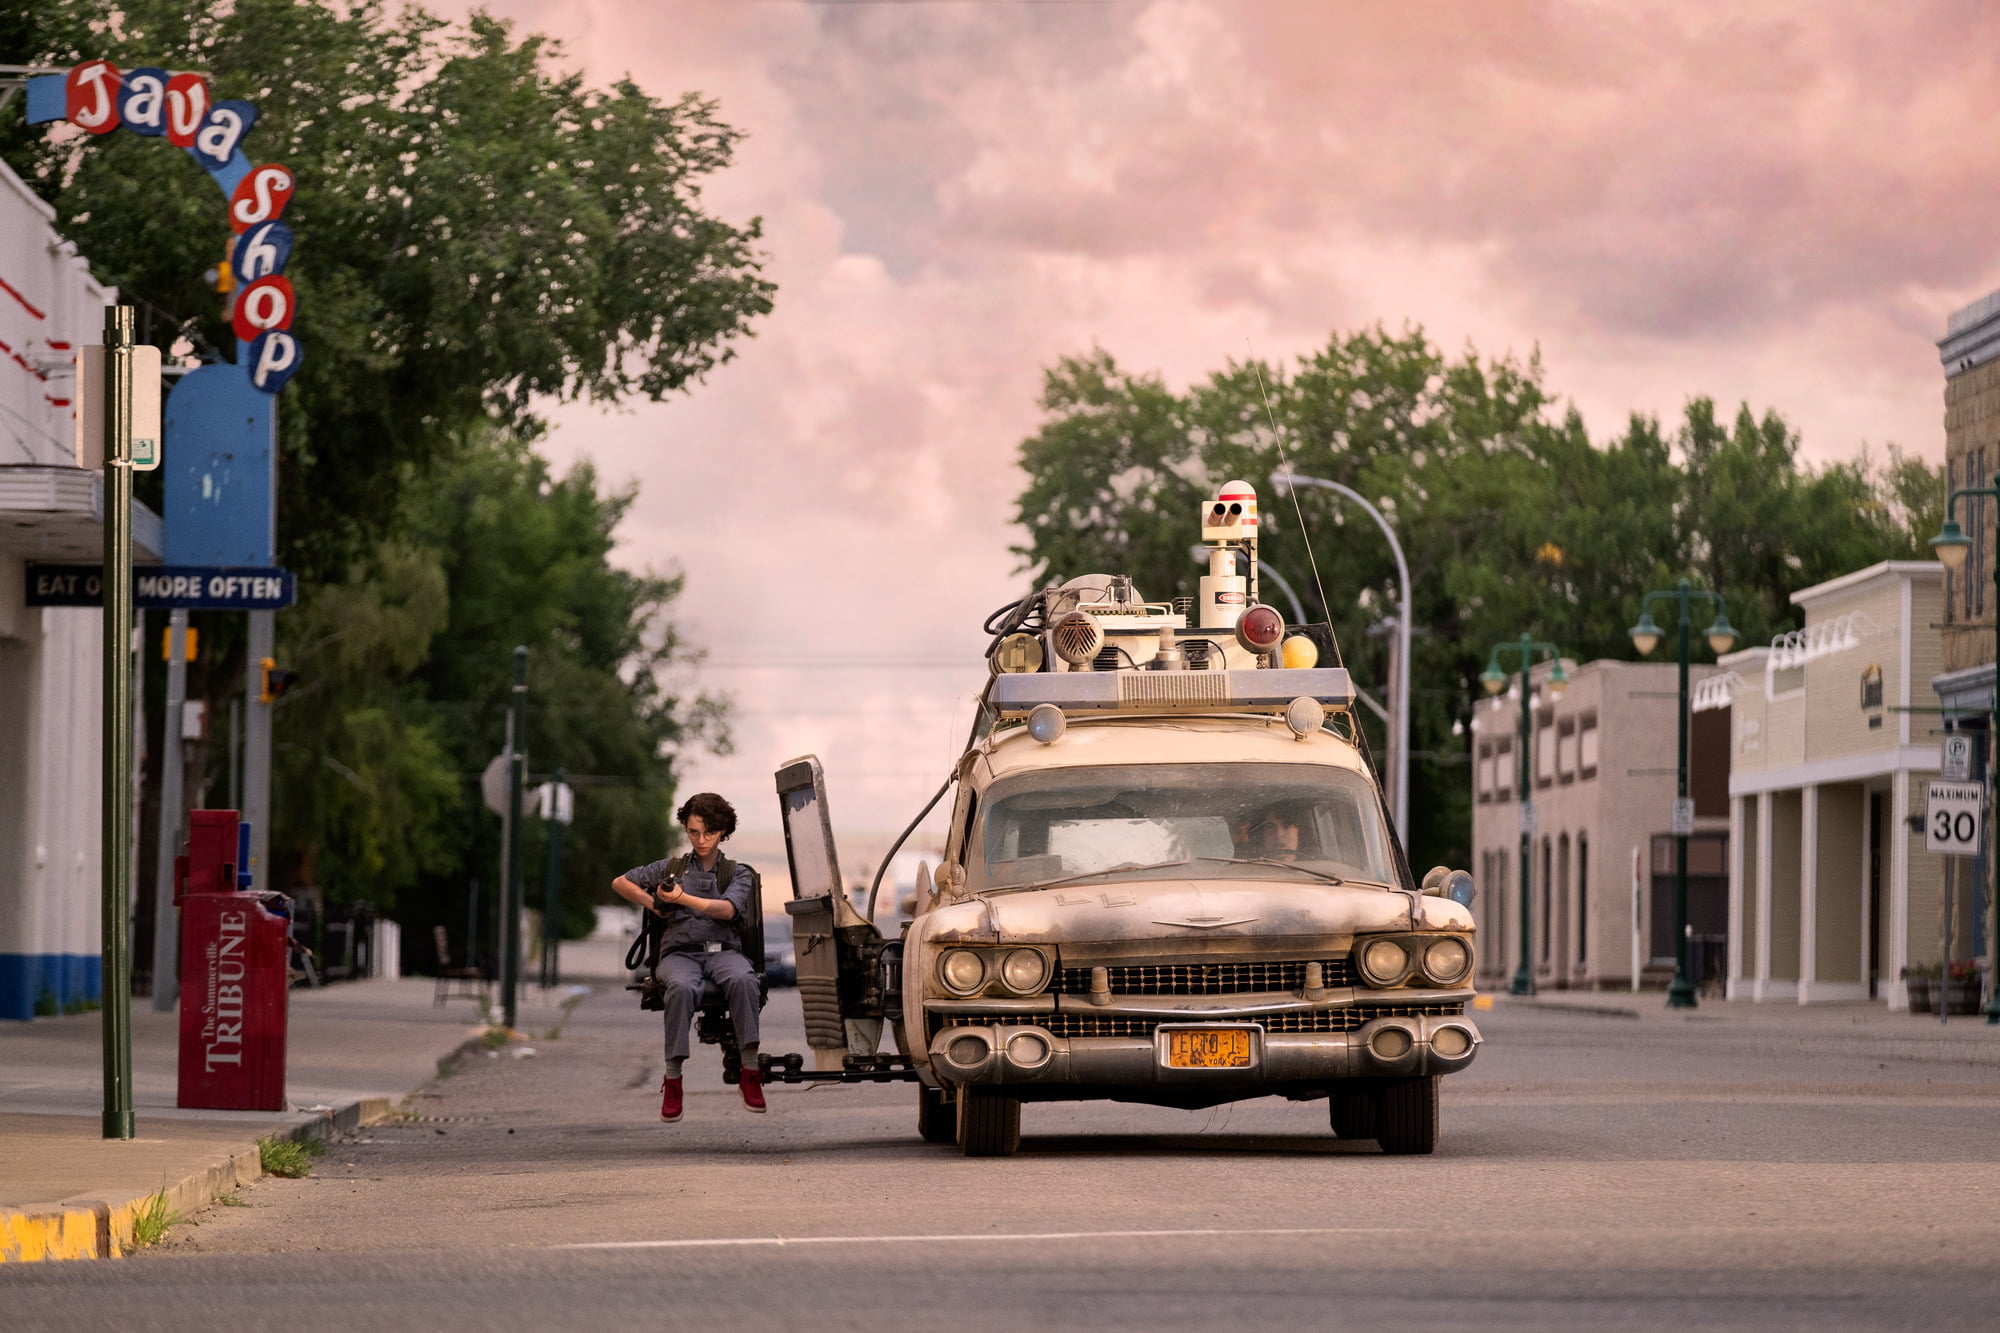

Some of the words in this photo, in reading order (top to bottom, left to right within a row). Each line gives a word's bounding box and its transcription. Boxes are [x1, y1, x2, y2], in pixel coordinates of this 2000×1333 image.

[75, 63, 243, 163] Java
[233, 168, 297, 388] Shop
[37, 576, 75, 596] EAT
[138, 576, 202, 598] MORE
[208, 576, 282, 599] OFTEN
[1930, 787, 1979, 801] MAXIMUM
[1933, 809, 1975, 844] 30
[202, 941, 218, 1014] Summerville
[205, 911, 246, 1073] TRIBUNE
[201, 1016, 216, 1039] The
[1190, 1057, 1205, 1065] NEW
[1209, 1057, 1227, 1065] YORK
